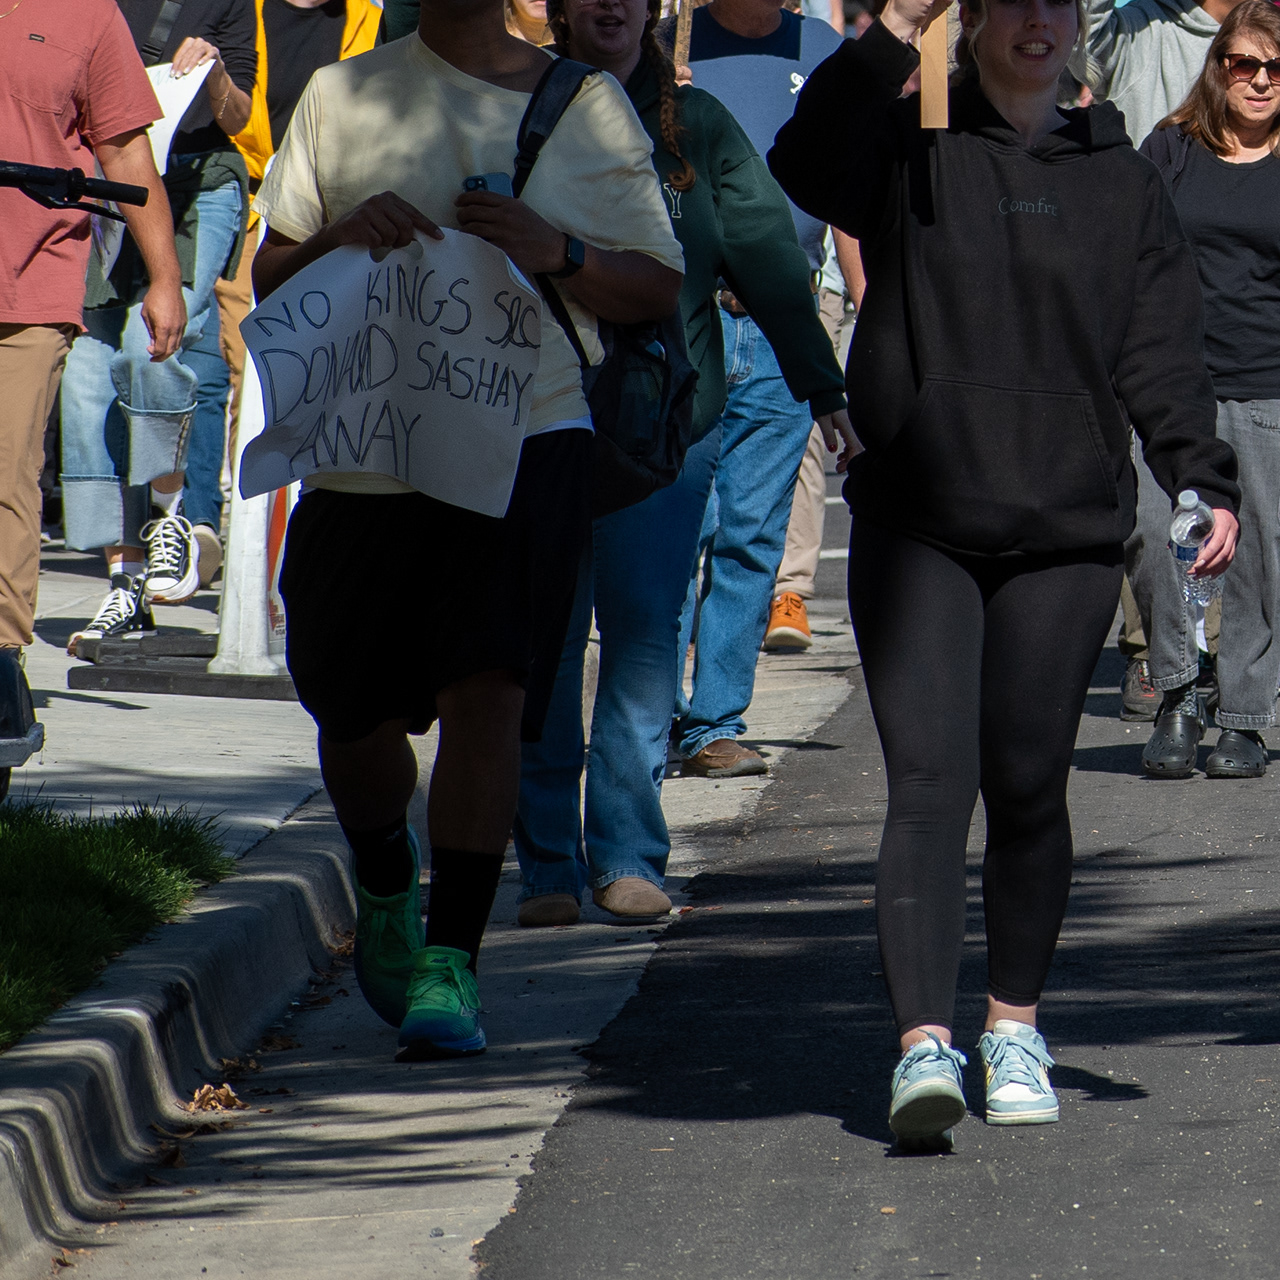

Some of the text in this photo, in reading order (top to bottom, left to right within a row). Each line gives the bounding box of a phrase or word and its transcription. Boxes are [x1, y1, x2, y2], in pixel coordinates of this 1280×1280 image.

[997, 196, 1059, 217] Comfrt
[252, 289, 333, 339] NO
[364, 262, 473, 336] KINGS
[407, 339, 536, 428] SASHAY
[288, 398, 423, 484] AWAY
